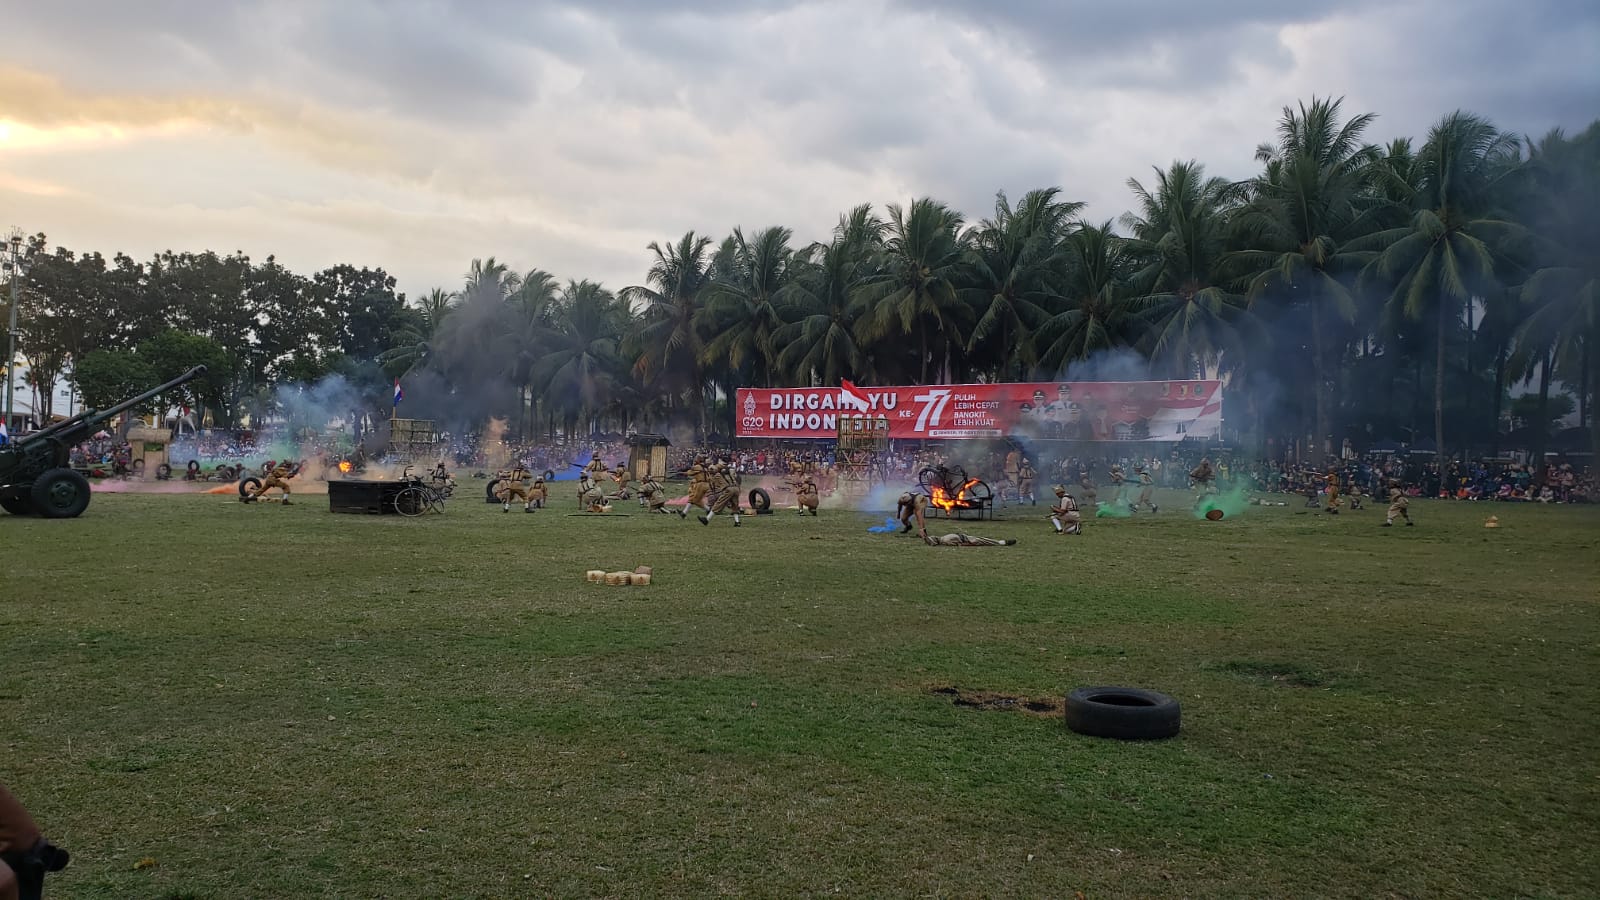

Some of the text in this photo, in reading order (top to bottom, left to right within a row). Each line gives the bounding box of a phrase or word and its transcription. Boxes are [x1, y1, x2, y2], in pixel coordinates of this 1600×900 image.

[770, 393, 897, 410] DIRGAHYU
[914, 389, 952, 432] 77
[743, 417, 764, 427] G20
[953, 418, 995, 426] LEBIH KUAT
